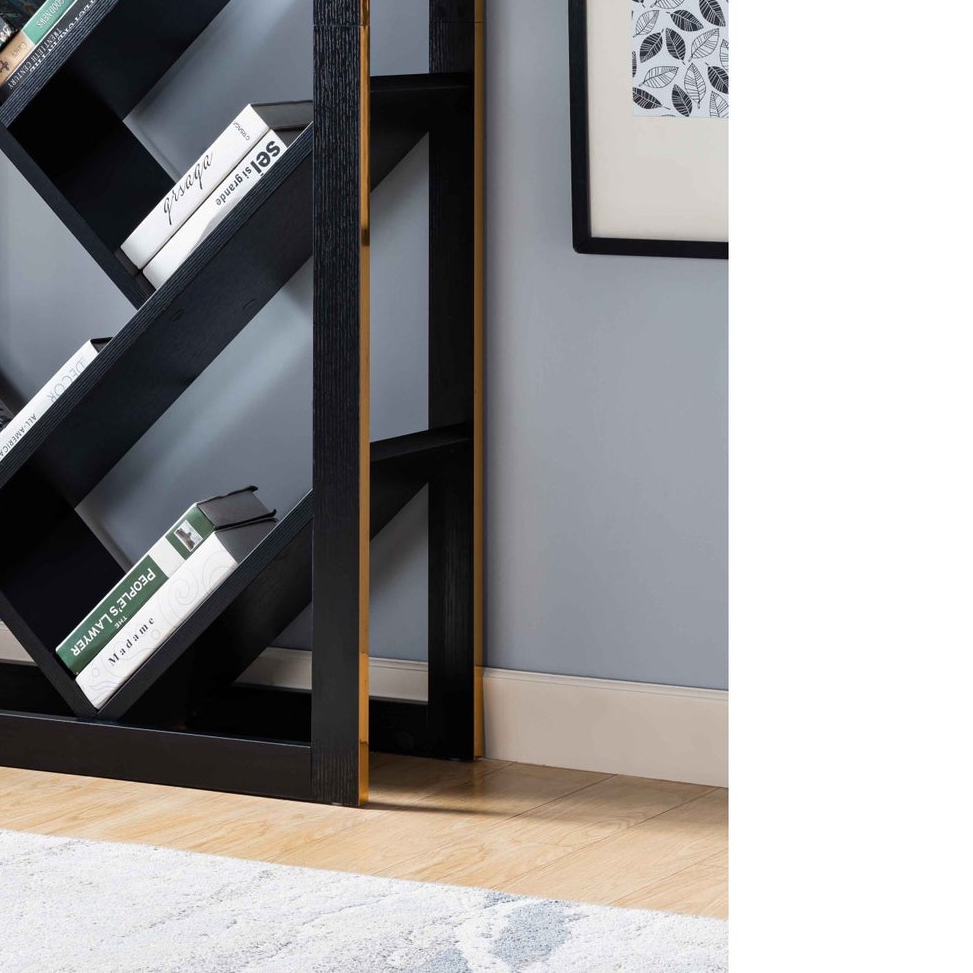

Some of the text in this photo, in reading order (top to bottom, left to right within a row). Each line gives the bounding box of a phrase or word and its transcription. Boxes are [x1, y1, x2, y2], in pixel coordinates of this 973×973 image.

[7, 59, 34, 90] CENTURY
[241, 167, 252, 180] si
[215, 174, 244, 206] grande
[71, 567, 157, 657] PEOPLE'S LAWYER
[113, 616, 128, 629] THE
[108, 618, 155, 666] Madame
